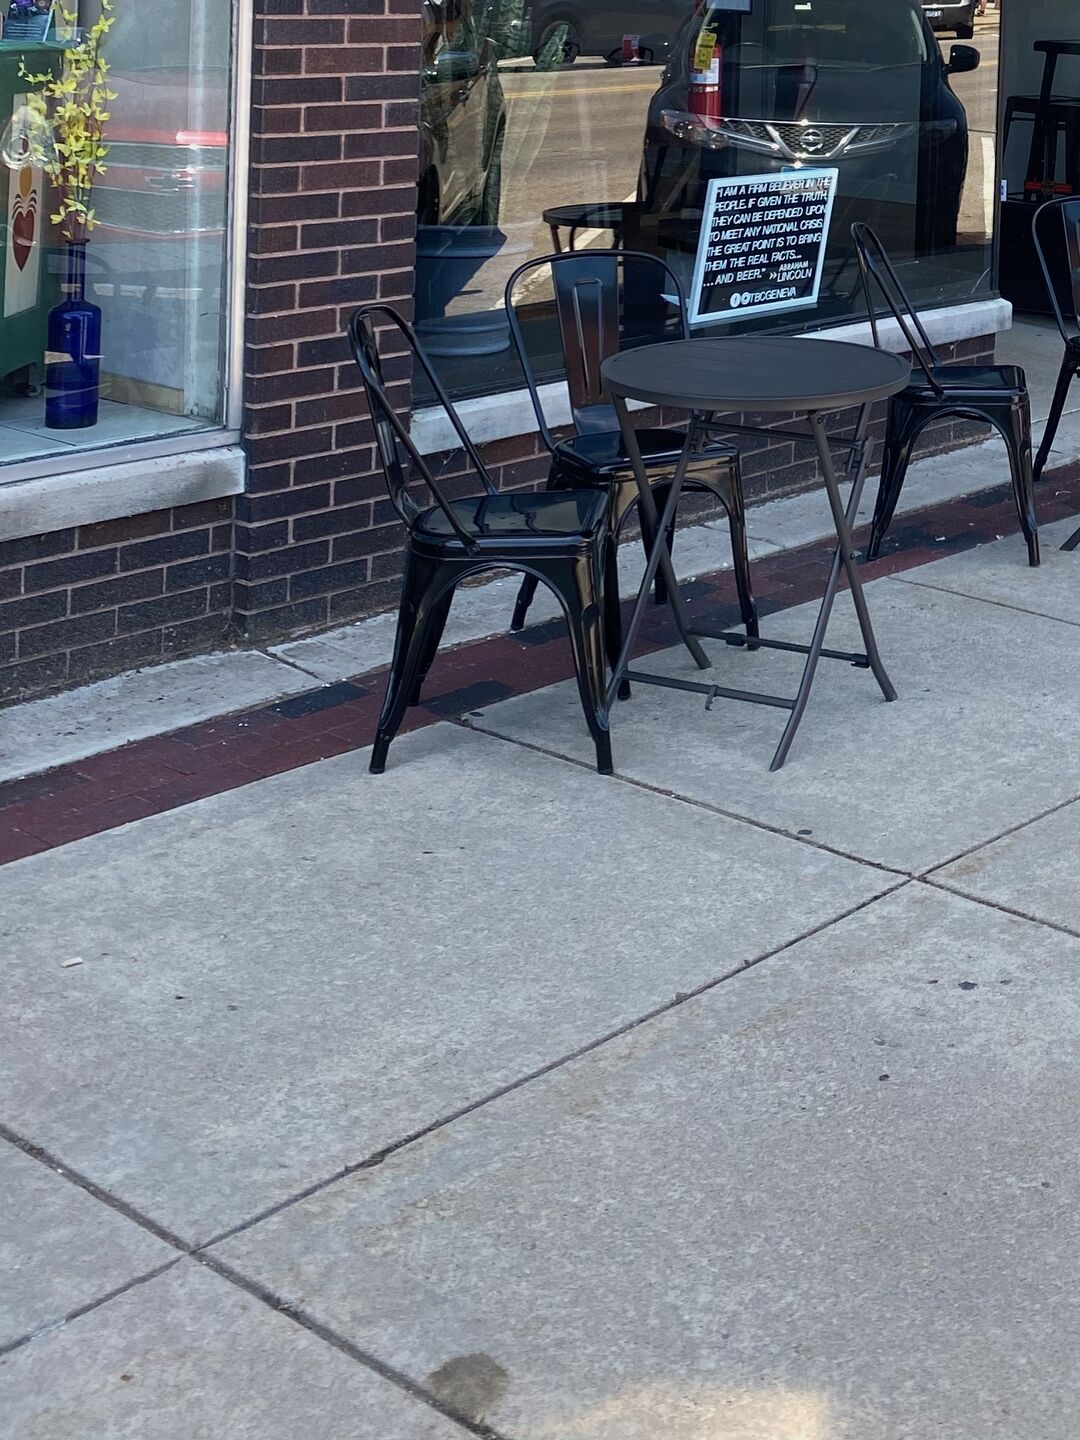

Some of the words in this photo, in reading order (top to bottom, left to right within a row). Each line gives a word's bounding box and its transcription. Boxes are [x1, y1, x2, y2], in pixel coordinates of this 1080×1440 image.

[724, 186, 737, 196] AM
[739, 185, 745, 195] A
[748, 184, 767, 194] FIRM
[769, 180, 803, 191] BELIEVER
[804, 178, 814, 189] IN
[816, 176, 831, 188] THE
[748, 198, 756, 208] IF
[757, 196, 781, 207] GIVEN
[784, 194, 798, 204] THE
[712, 215, 733, 227] THEY
[733, 213, 751, 225] CAN
[752, 212, 763, 222] BE
[764, 207, 803, 220] DEPENDED
[805, 205, 827, 215] UPON
[710, 231, 720, 242] TO
[721, 228, 743, 240] MEET
[743, 226, 763, 237] ANY
[762, 222, 798, 235] NATIONAL
[707, 245, 723, 257] THE
[724, 242, 751, 254] GREAT
[752, 238, 775, 251] POINT
[776, 237, 784, 247] IS
[786, 235, 797, 246] TO
[798, 233, 822, 244] BRING
[705, 260, 726, 272] THEM
[730, 257, 745, 268] THE
[747, 254, 769, 266] REAL
[779, 261, 808, 271] ABRAHAM
[777, 268, 812, 282] LINCOLN
[750, 287, 796, 302] TBCGENEVA
